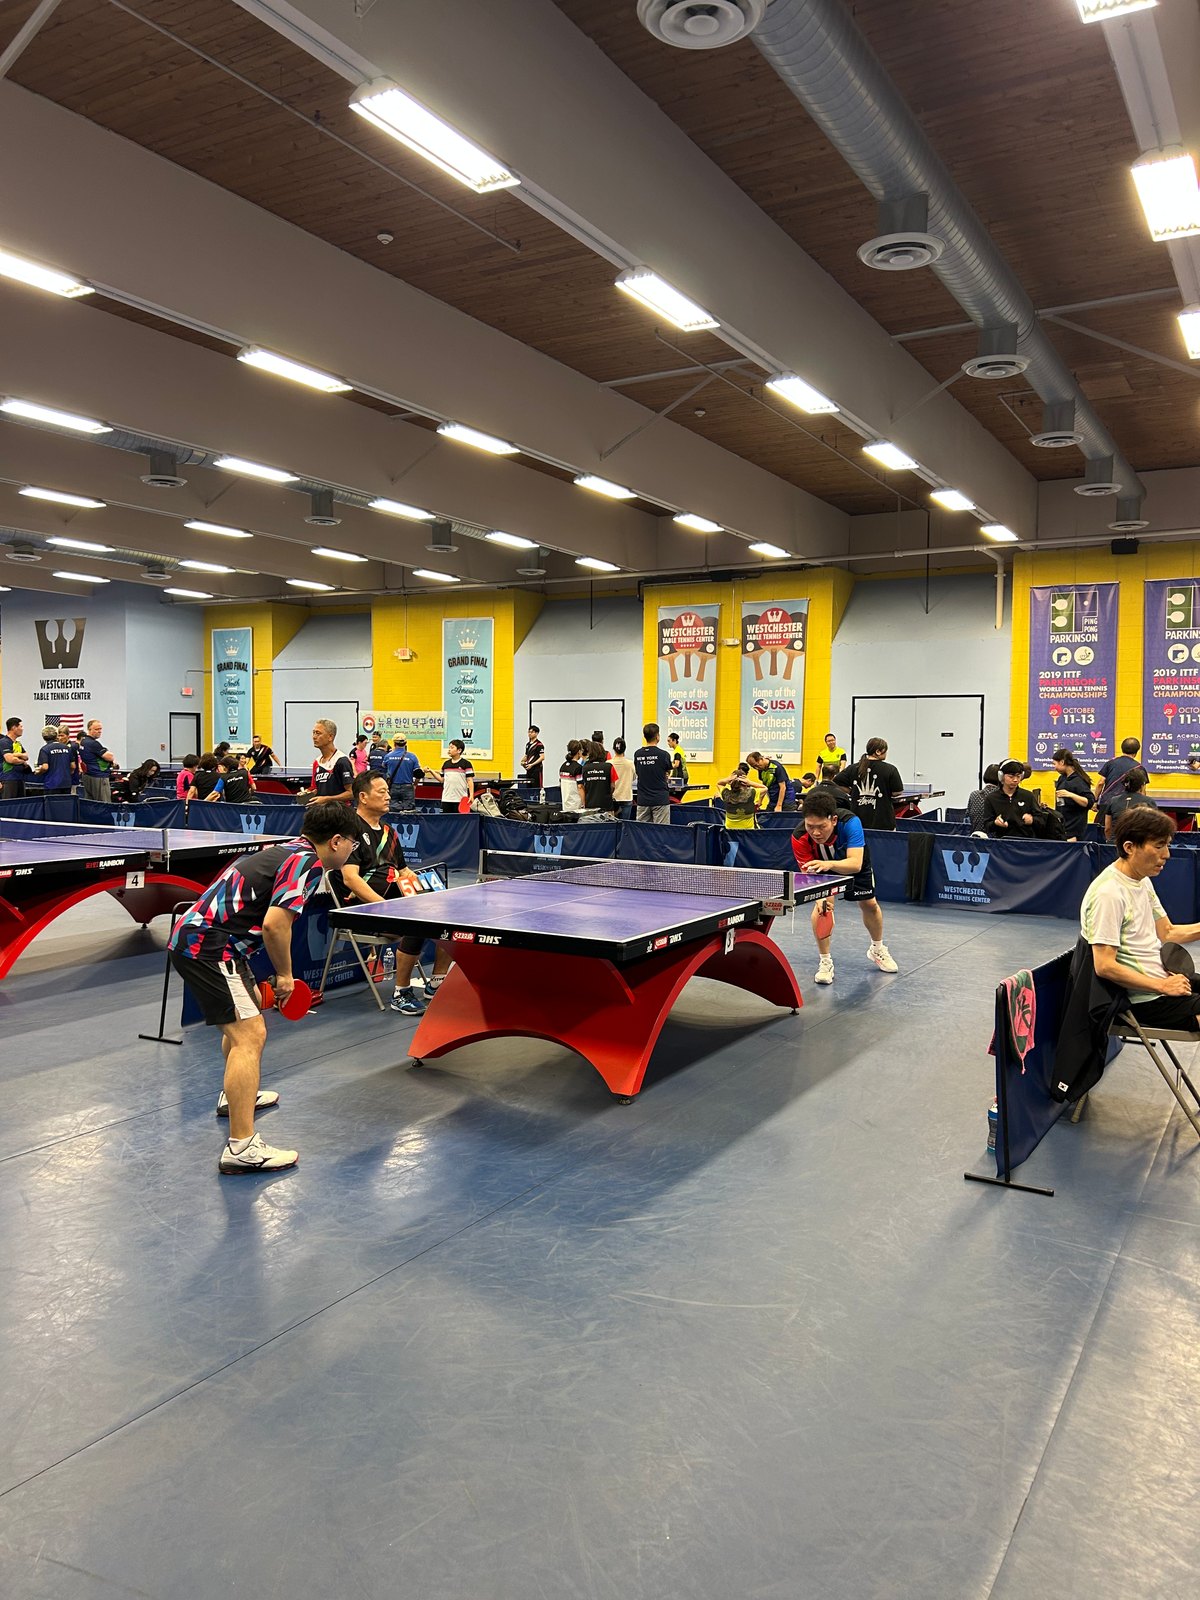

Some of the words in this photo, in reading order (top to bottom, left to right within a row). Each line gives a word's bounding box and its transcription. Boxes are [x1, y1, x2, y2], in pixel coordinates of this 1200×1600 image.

[662, 626, 714, 637] WESTCHESTER
[747, 622, 802, 633] WESTCHESTER
[1050, 634, 1098, 643] PARKINSON
[217, 662, 233, 672] GRAND
[234, 662, 248, 672] FINAL
[448, 656, 469, 668] GRAND
[471, 656, 487, 668] FINAL
[40, 679, 84, 689] WESTCHESTER
[457, 676, 477, 684] North
[669, 689, 687, 698] Home
[689, 689, 696, 698] of
[697, 689, 708, 698] the
[753, 687, 772, 697] Home
[775, 687, 782, 697] of
[784, 687, 796, 697] the
[685, 701, 707, 710] USA
[771, 700, 795, 709] USA
[378, 718, 392, 728] 뉴욕
[395, 718, 409, 728] 한인
[412, 718, 426, 728] 탁구
[429, 718, 444, 728] 협회
[668, 716, 708, 727] Northeast
[752, 716, 795, 727] Northeast
[1063, 714, 1095, 724] 11-13
[752, 728, 795, 743] Regionals
[99, 859, 125, 868] RAINBOW
[131, 875, 139, 886] 4
[400, 879, 417, 896] 5
[944, 886, 985, 896] WESTCHESTER
[727, 913, 745, 925] RAINBOW
[478, 934, 502, 944] DHS
[335, 971, 354, 982] CENTER
